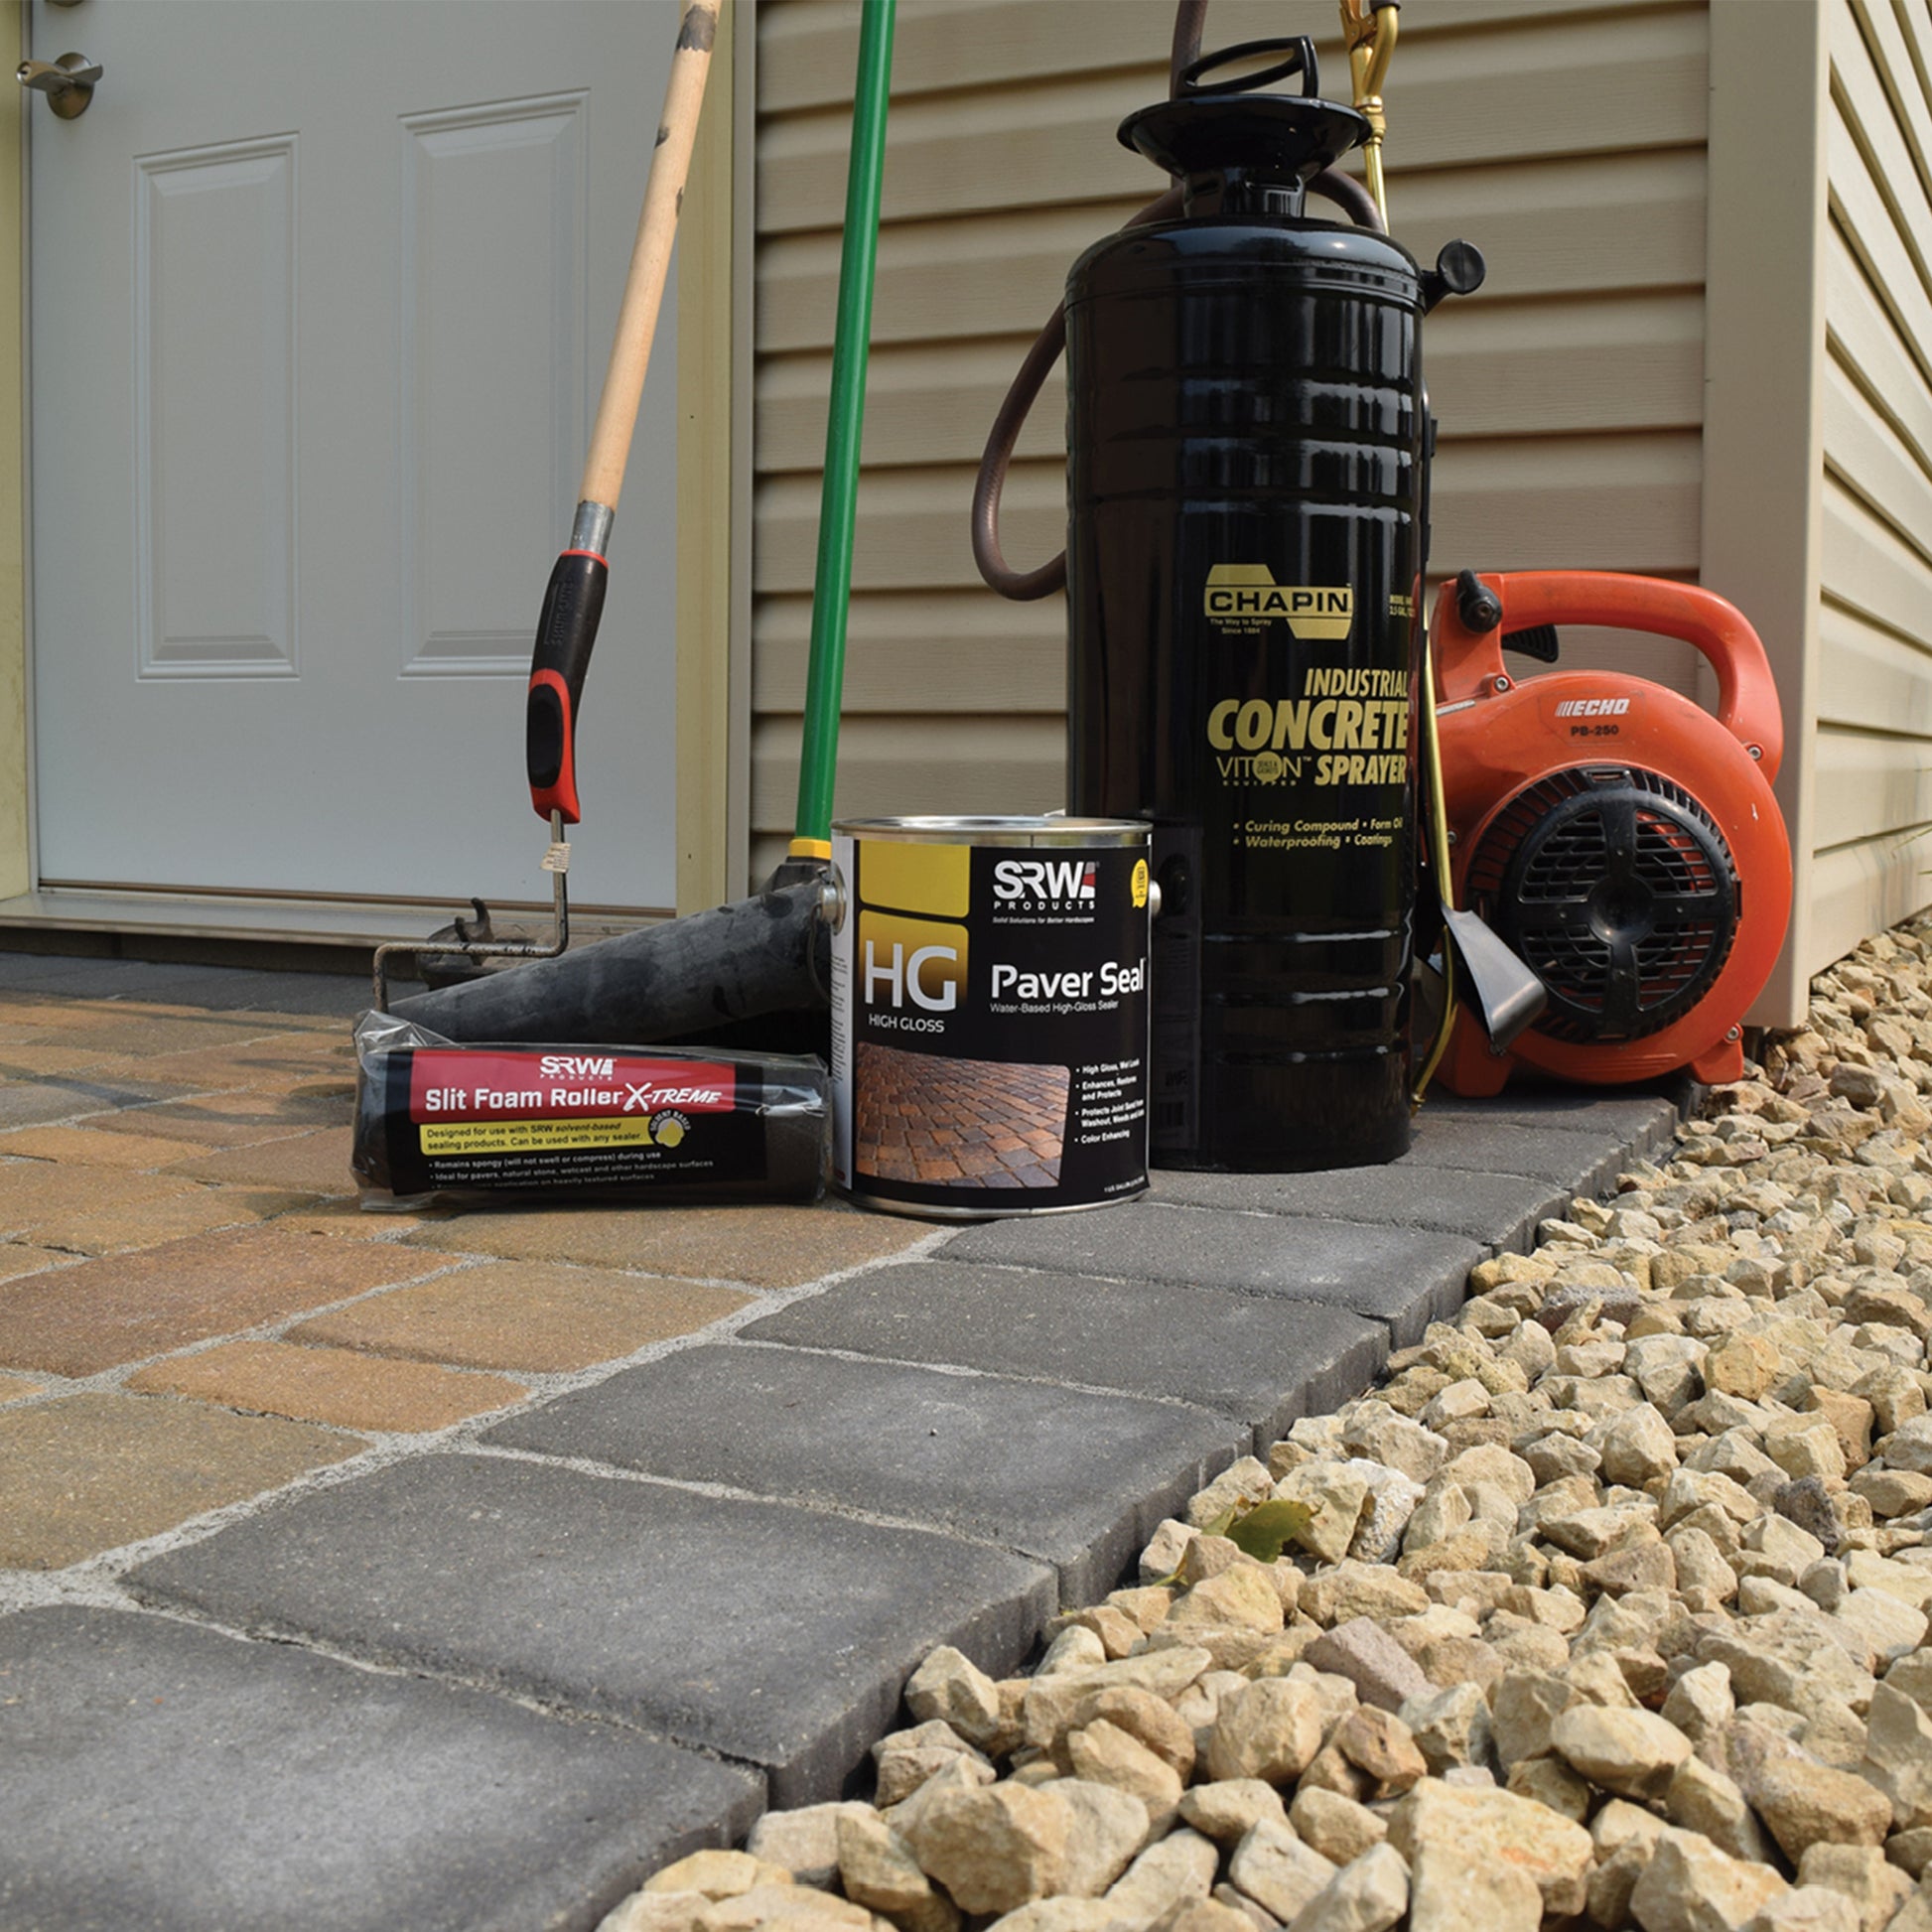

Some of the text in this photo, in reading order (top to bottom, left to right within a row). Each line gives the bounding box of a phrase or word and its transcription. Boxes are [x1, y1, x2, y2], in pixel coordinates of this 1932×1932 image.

[1209, 591, 1348, 613] CHAPIN
[1250, 618, 1272, 626] Spray
[1304, 668, 1408, 697] INDUSTRIAL
[1572, 698, 1630, 716] ECHO
[1207, 699, 1409, 751] CONCRETE
[1571, 725, 1619, 737] PB-250
[1314, 755, 1407, 785] SPRAYER
[1245, 820, 1290, 835] Curing
[1294, 818, 1359, 834] Compound
[1370, 818, 1391, 830] Form
[1245, 834, 1392, 850] Waterproofing Coatings
[993, 860, 1085, 899] SRW
[994, 900, 1095, 910] PRODUCTS
[865, 939, 957, 1012] HG
[991, 958, 1145, 999] Paver Seal
[990, 1000, 1119, 1015] Water-Based High-Gloss Sealer
[869, 1013, 945, 1034] HIGH GLOSS
[539, 1055, 605, 1075] SRW
[1082, 1064, 1099, 1075] High
[425, 1082, 722, 1112] Slit Foam Roller X-TREME
[1082, 1092, 1095, 1101] and
[427, 1127, 471, 1138] Designed
[474, 1127, 486, 1136] for
[556, 1122, 621, 1132] solvent-based
[427, 1140, 462, 1150] sealing
[464, 1139, 507, 1149] products.
[510, 1137, 529, 1146] Can
[532, 1136, 543, 1145] be
[546, 1135, 569, 1144] used
[572, 1134, 591, 1143] with
[594, 1135, 611, 1144] any
[1080, 1134, 1101, 1144] Color
[434, 1160, 470, 1169] Remains
[472, 1159, 502, 1169] spongy
[504, 1158, 521, 1168] (will
[573, 1153, 616, 1163] compress)
[618, 1152, 644, 1161] during
[502, 1169, 531, 1177] natural
[634, 1162, 677, 1171] hardscape
